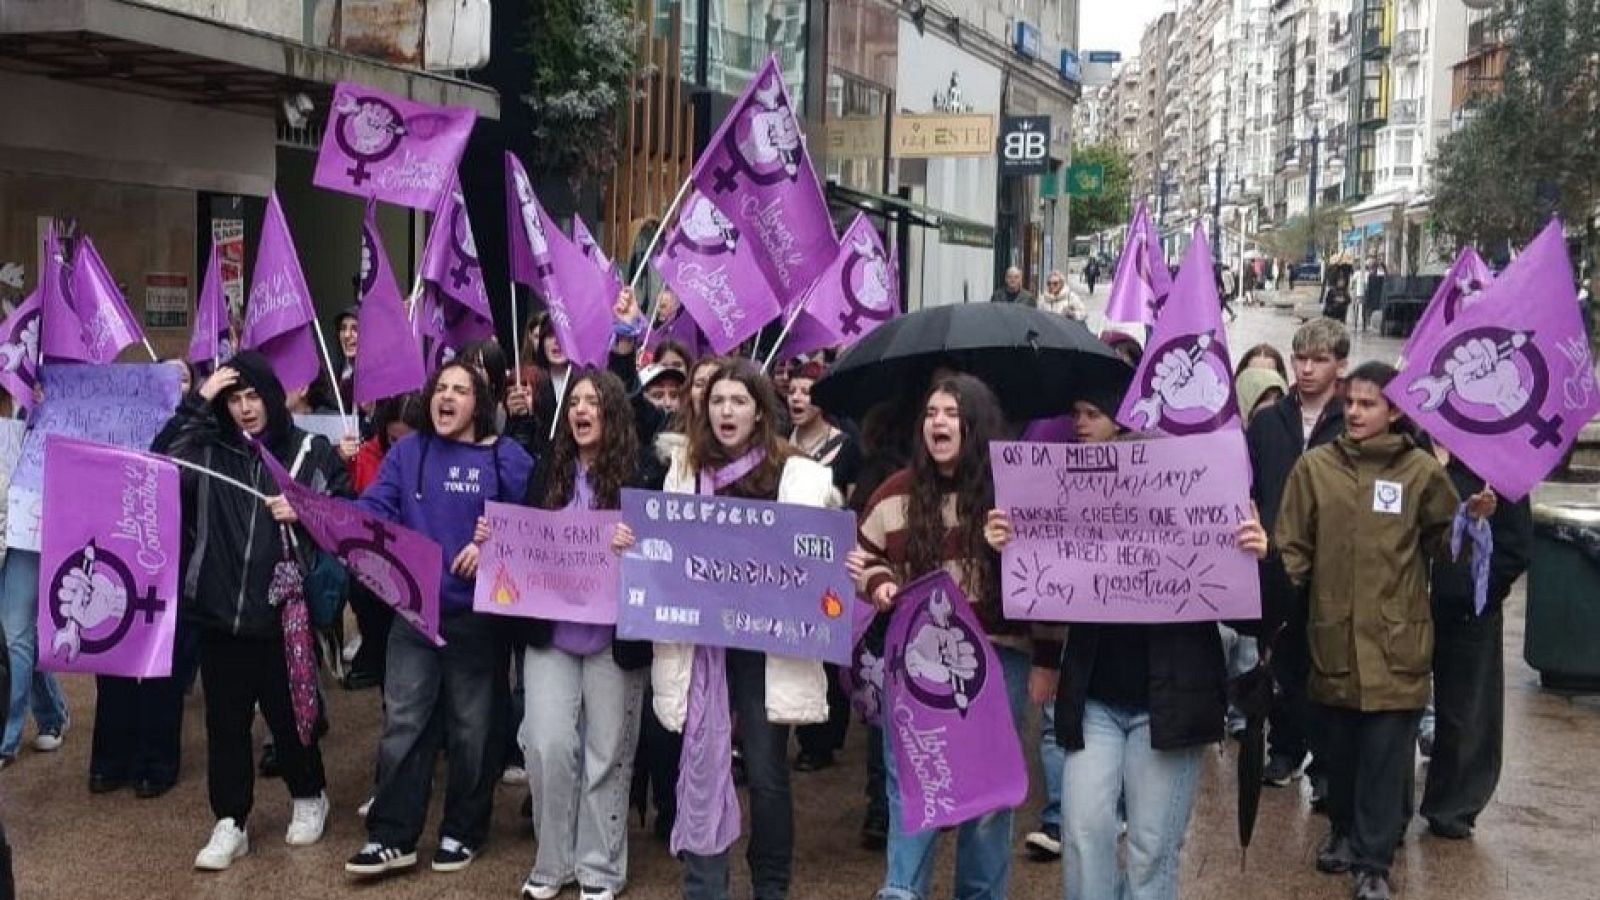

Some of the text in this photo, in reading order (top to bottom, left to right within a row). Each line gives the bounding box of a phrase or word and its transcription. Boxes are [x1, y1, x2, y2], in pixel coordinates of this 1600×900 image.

[1031, 445, 1052, 467] DA
[1065, 444, 1119, 470] MIEDO
[1131, 443, 1148, 465] EL
[443, 481, 480, 493] TOKYO
[1148, 506, 1177, 526] QUE
[1184, 505, 1229, 525] VAMOS
[1013, 523, 1064, 540] HACER
[1074, 525, 1103, 540] CON
[1192, 531, 1210, 547] LO
[796, 536, 832, 561] SER
